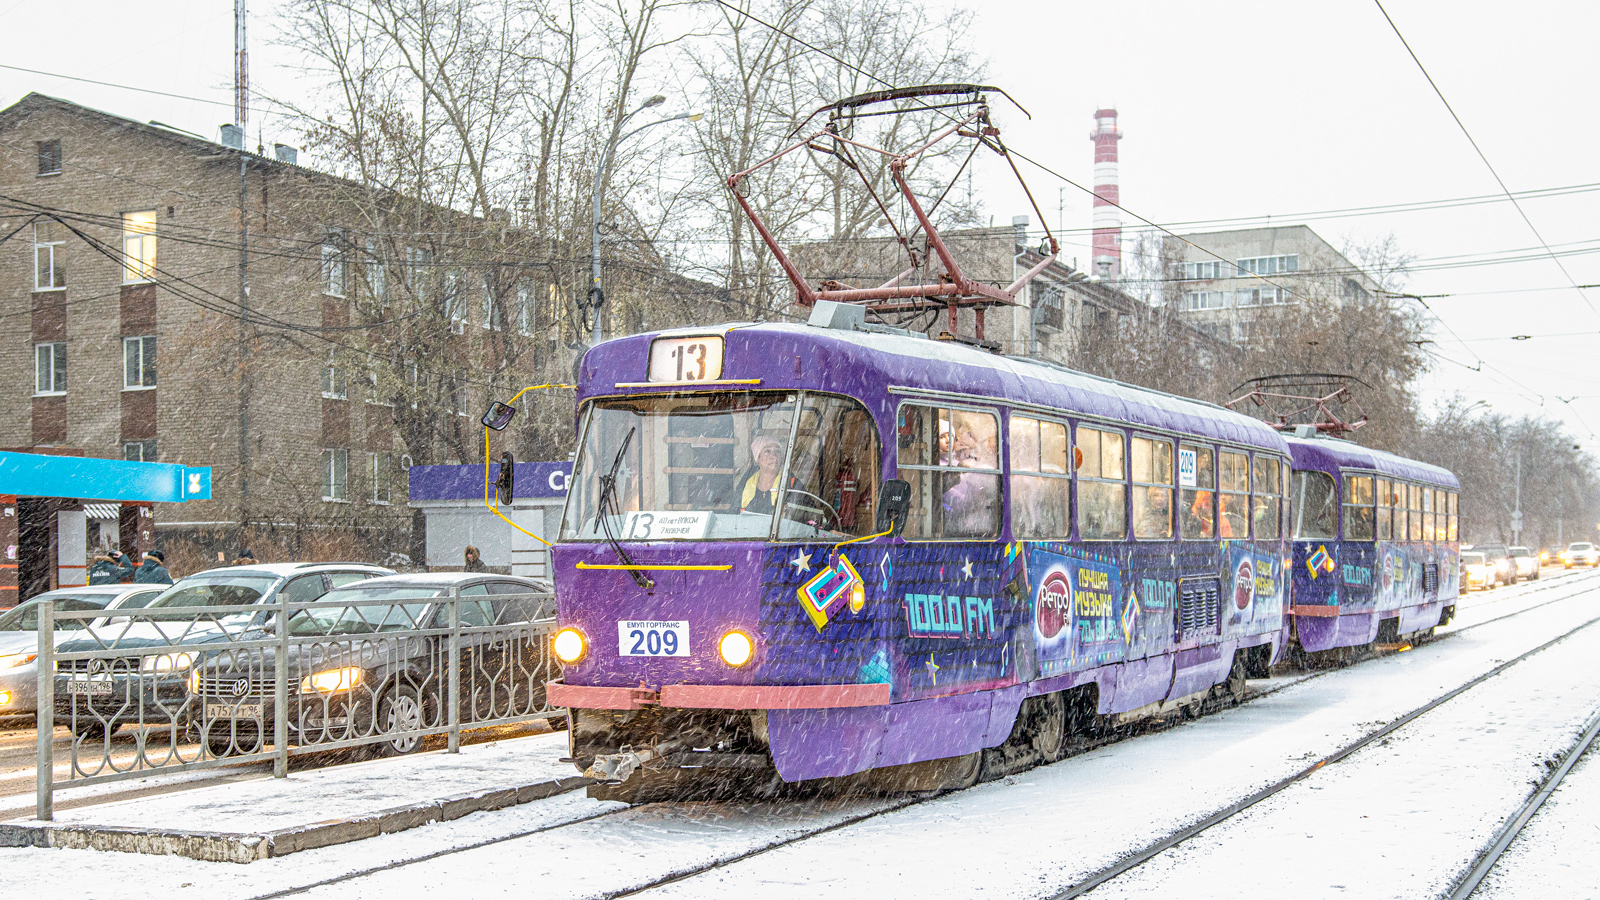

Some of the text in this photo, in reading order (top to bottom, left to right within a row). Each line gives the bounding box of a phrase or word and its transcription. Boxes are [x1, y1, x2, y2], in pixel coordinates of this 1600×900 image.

[671, 343, 707, 381] 13
[1181, 451, 1193, 473] 209
[628, 513, 654, 539] 13
[1078, 567, 1109, 590] ЛУЧШАЯ
[1040, 584, 1069, 615] Ретро
[1074, 590, 1113, 617] МУЗЫКА
[626, 621, 680, 629] ЕМУП ГОРТРАНС
[903, 593, 995, 638] 100.0 FM
[629, 629, 679, 656] 209
